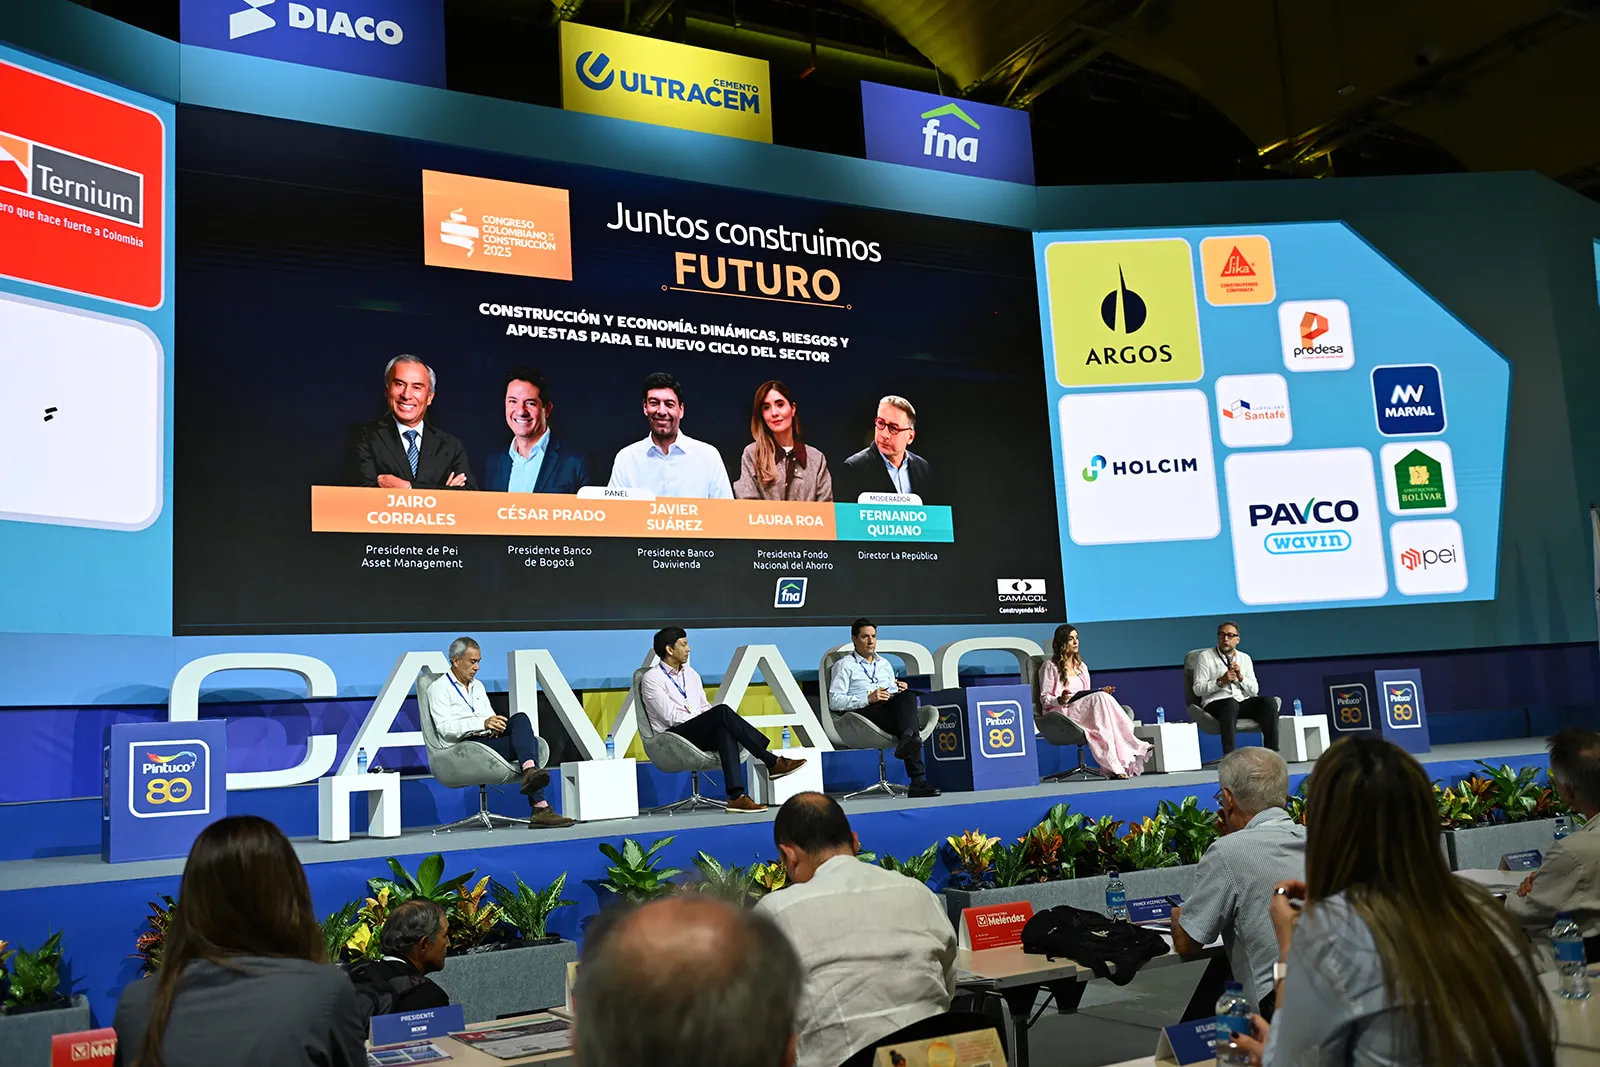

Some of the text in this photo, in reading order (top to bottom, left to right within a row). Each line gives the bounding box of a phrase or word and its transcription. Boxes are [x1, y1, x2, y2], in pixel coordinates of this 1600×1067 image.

[288, 2, 404, 45] DIACO
[619, 70, 760, 114] ULTRACEM
[713, 78, 759, 93] CEMENTO
[922, 118, 979, 162] fna
[36, 164, 133, 215] Ternium
[16, 207, 34, 218] que
[38, 210, 61, 226] hace
[64, 218, 92, 234] fuerte
[94, 228, 100, 236] a
[102, 228, 144, 248] Colombia
[482, 215, 535, 229] CONGRESO
[482, 224, 547, 240] COLOMBIANO
[606, 202, 882, 262] Juntos construimos
[483, 234, 556, 251] CONSTRUCCIÓN
[483, 244, 513, 258] 2025
[1224, 256, 1250, 274] Sika
[674, 251, 841, 302] FUTURO
[479, 303, 850, 348] CONSTRUCCIÓN Y ECONOMÍA: DINÁMICAS, RIESGOS Y
[506, 324, 830, 363] APUESTAS PARA EL NUEVO CICLO DEL SECTOR
[1086, 344, 1172, 365] ARGOS
[1294, 344, 1344, 358] prodesa
[1244, 410, 1286, 420] Santafé
[1384, 406, 1435, 418] MARVAL
[1112, 458, 1198, 476] HOLCIM
[387, 494, 437, 508] JAIRO
[1402, 492, 1442, 502] BOLÍVAR
[497, 504, 606, 522] CÉSAR PRADO
[650, 503, 698, 516] JAVIER
[860, 510, 928, 522] FERNANDO
[1249, 498, 1358, 527] PAVCO
[367, 512, 456, 526] CORRALES
[646, 516, 703, 531] SUÁREZ
[748, 514, 824, 526] LAURA ROA
[868, 525, 922, 538] QUIJANO
[1273, 535, 1342, 550] wavin
[366, 545, 459, 556] Presidente de Pei
[508, 546, 592, 556] Presidente Banco
[637, 548, 714, 558] Presidente Banco
[757, 550, 828, 559] Presidenta Fondo
[858, 551, 938, 561] Director La República
[1422, 544, 1456, 570] pei
[361, 558, 464, 570] Asset Management
[524, 558, 575, 568] de Bogotá
[652, 560, 701, 569] Davivienda
[754, 561, 834, 570] Nacional del Ahorro
[781, 589, 800, 602] fna
[1390, 694, 1411, 702] Pintuco
[1341, 707, 1362, 723] 80
[1394, 704, 1413, 720] 80
[985, 716, 1012, 726] Pintuco
[938, 732, 957, 752] 80
[989, 728, 1015, 748] 80
[142, 762, 191, 774] Pintuco
[146, 777, 192, 804] 80
[986, 912, 1026, 926] Meléndez
[400, 1012, 435, 1022] PRESIDENTE
